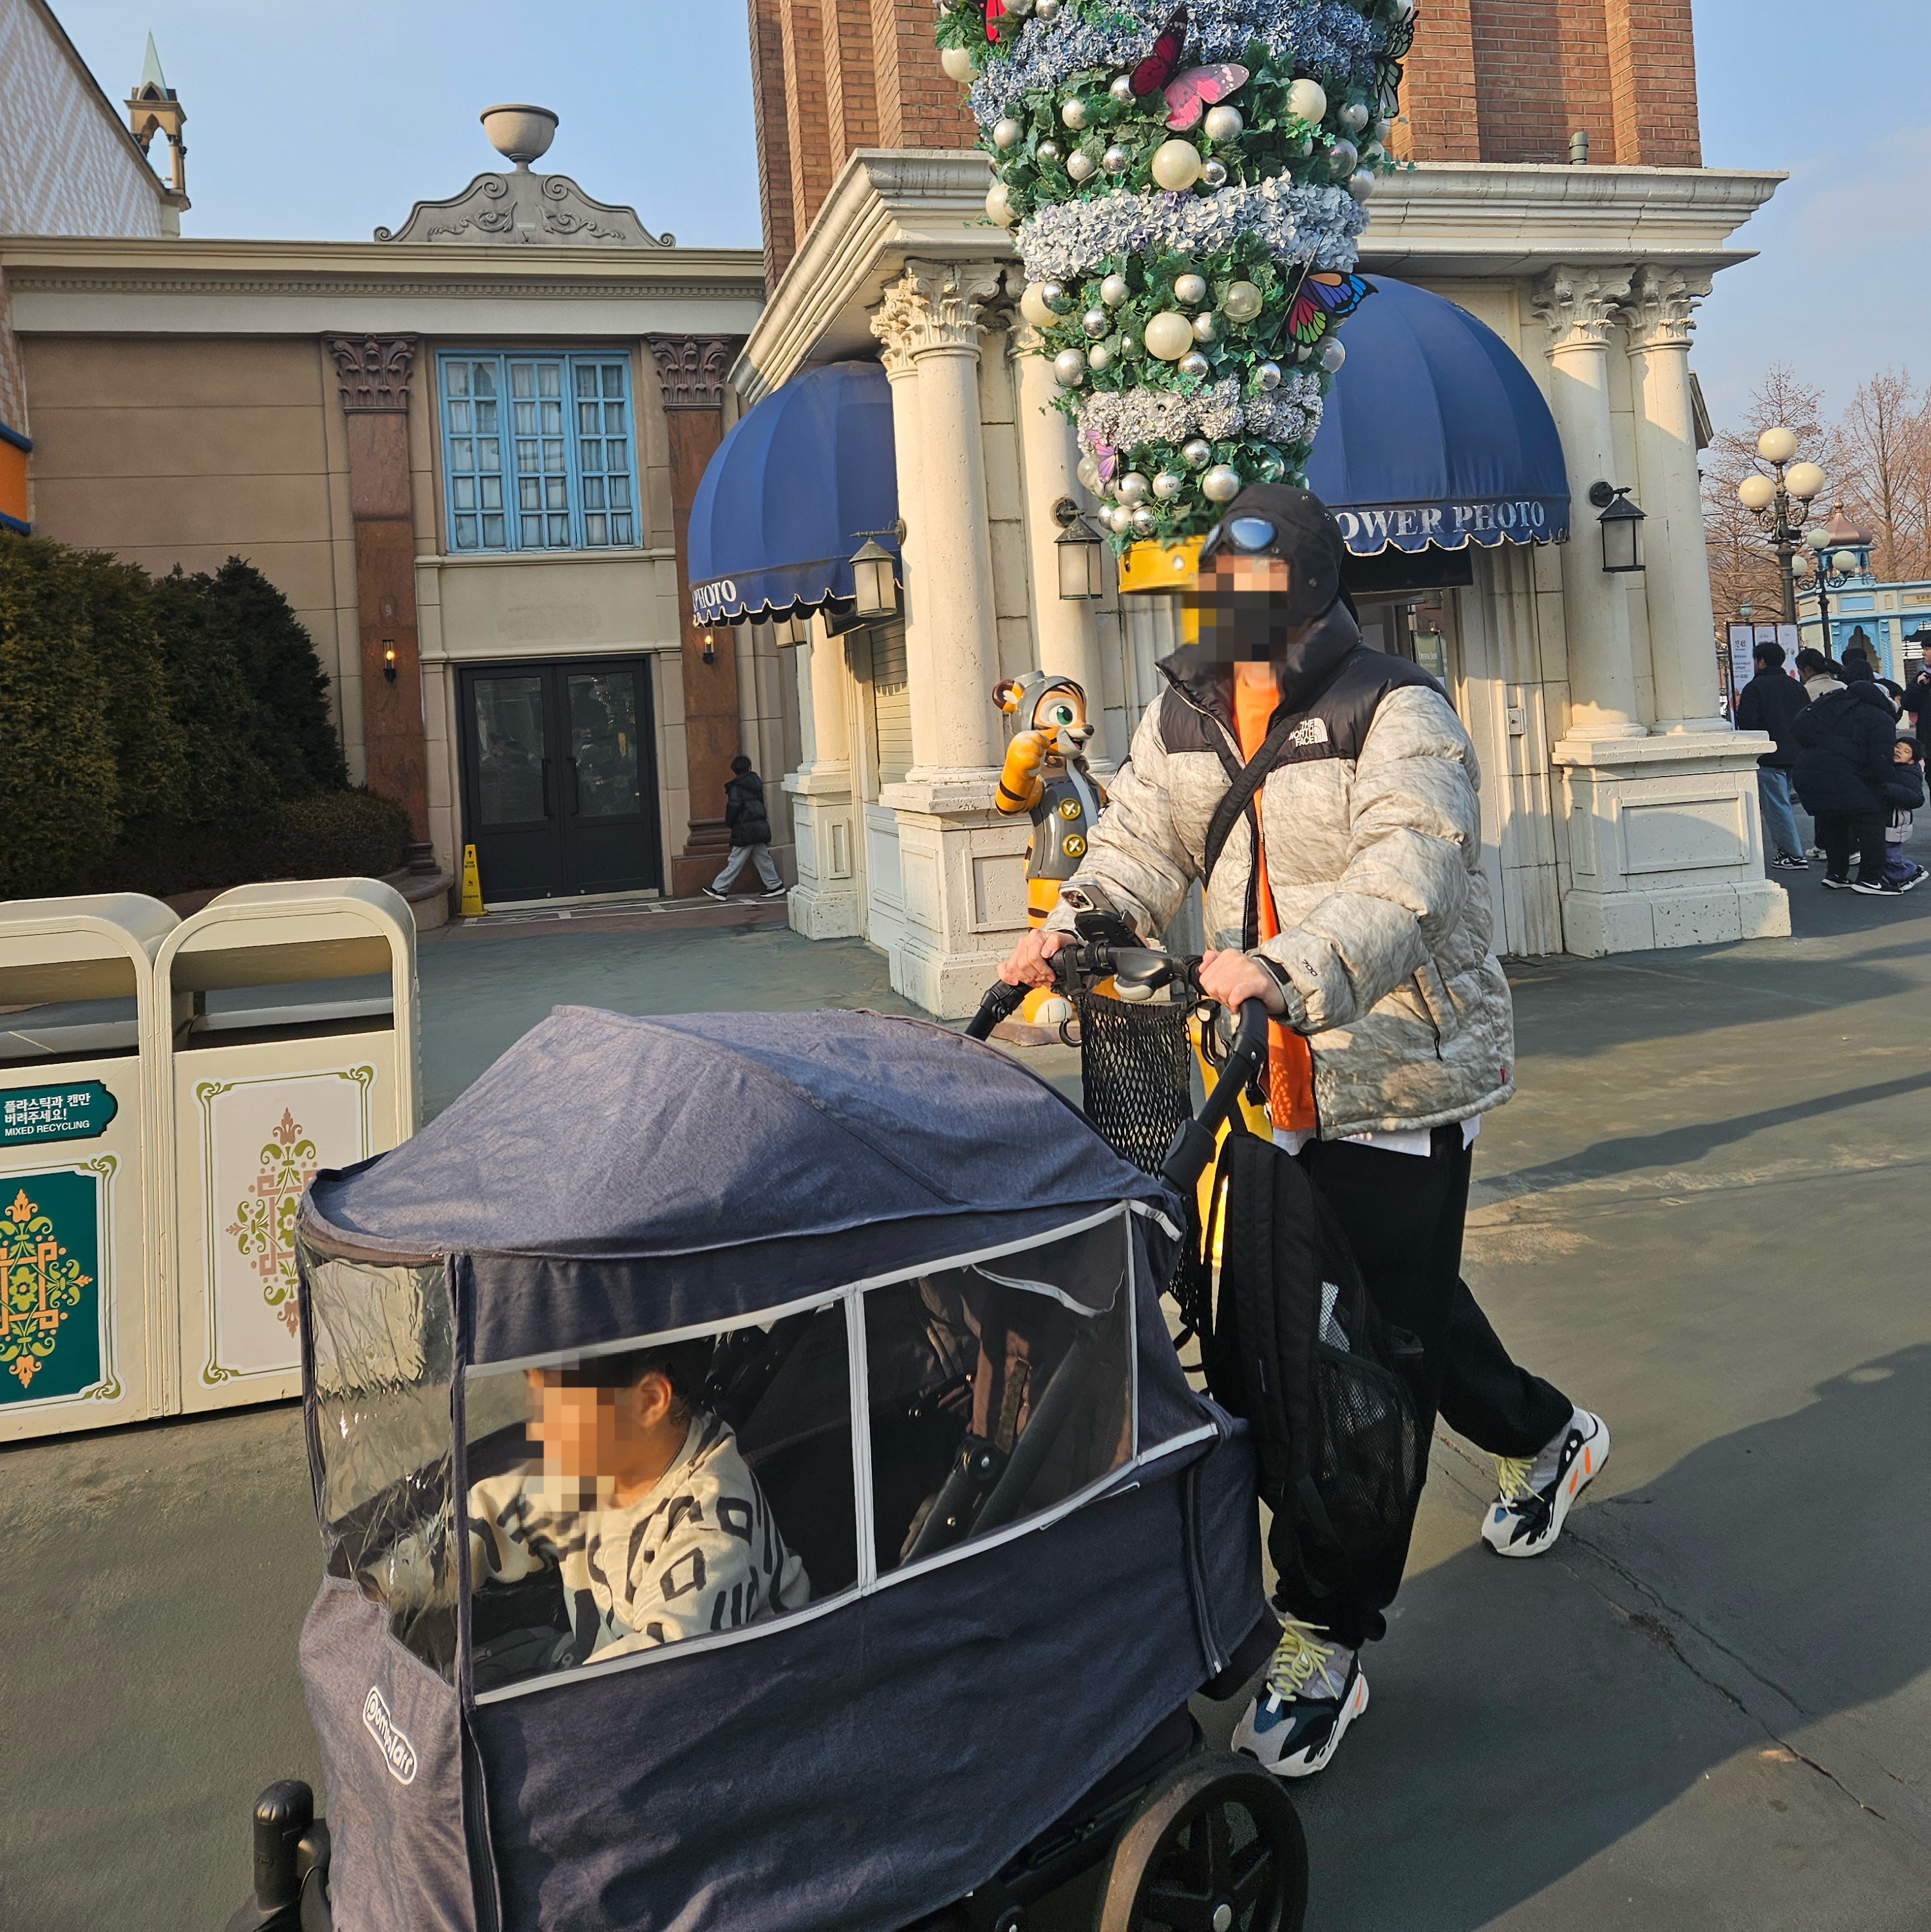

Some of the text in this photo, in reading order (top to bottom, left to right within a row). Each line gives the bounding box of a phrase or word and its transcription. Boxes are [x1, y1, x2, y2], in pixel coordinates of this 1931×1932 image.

[1453, 501, 1545, 533] PHOTO
[1300, 719, 1314, 729] THE
[1288, 727, 1314, 741] NORTH
[1295, 735, 1315, 747] FACE
[1301, 959, 1317, 976] 700
[4, 1093, 91, 1113] 플라스틱과 캔만
[4, 1108, 67, 1126] 버려주세요!
[5, 1120, 89, 1136] MIXED RECYCLING
